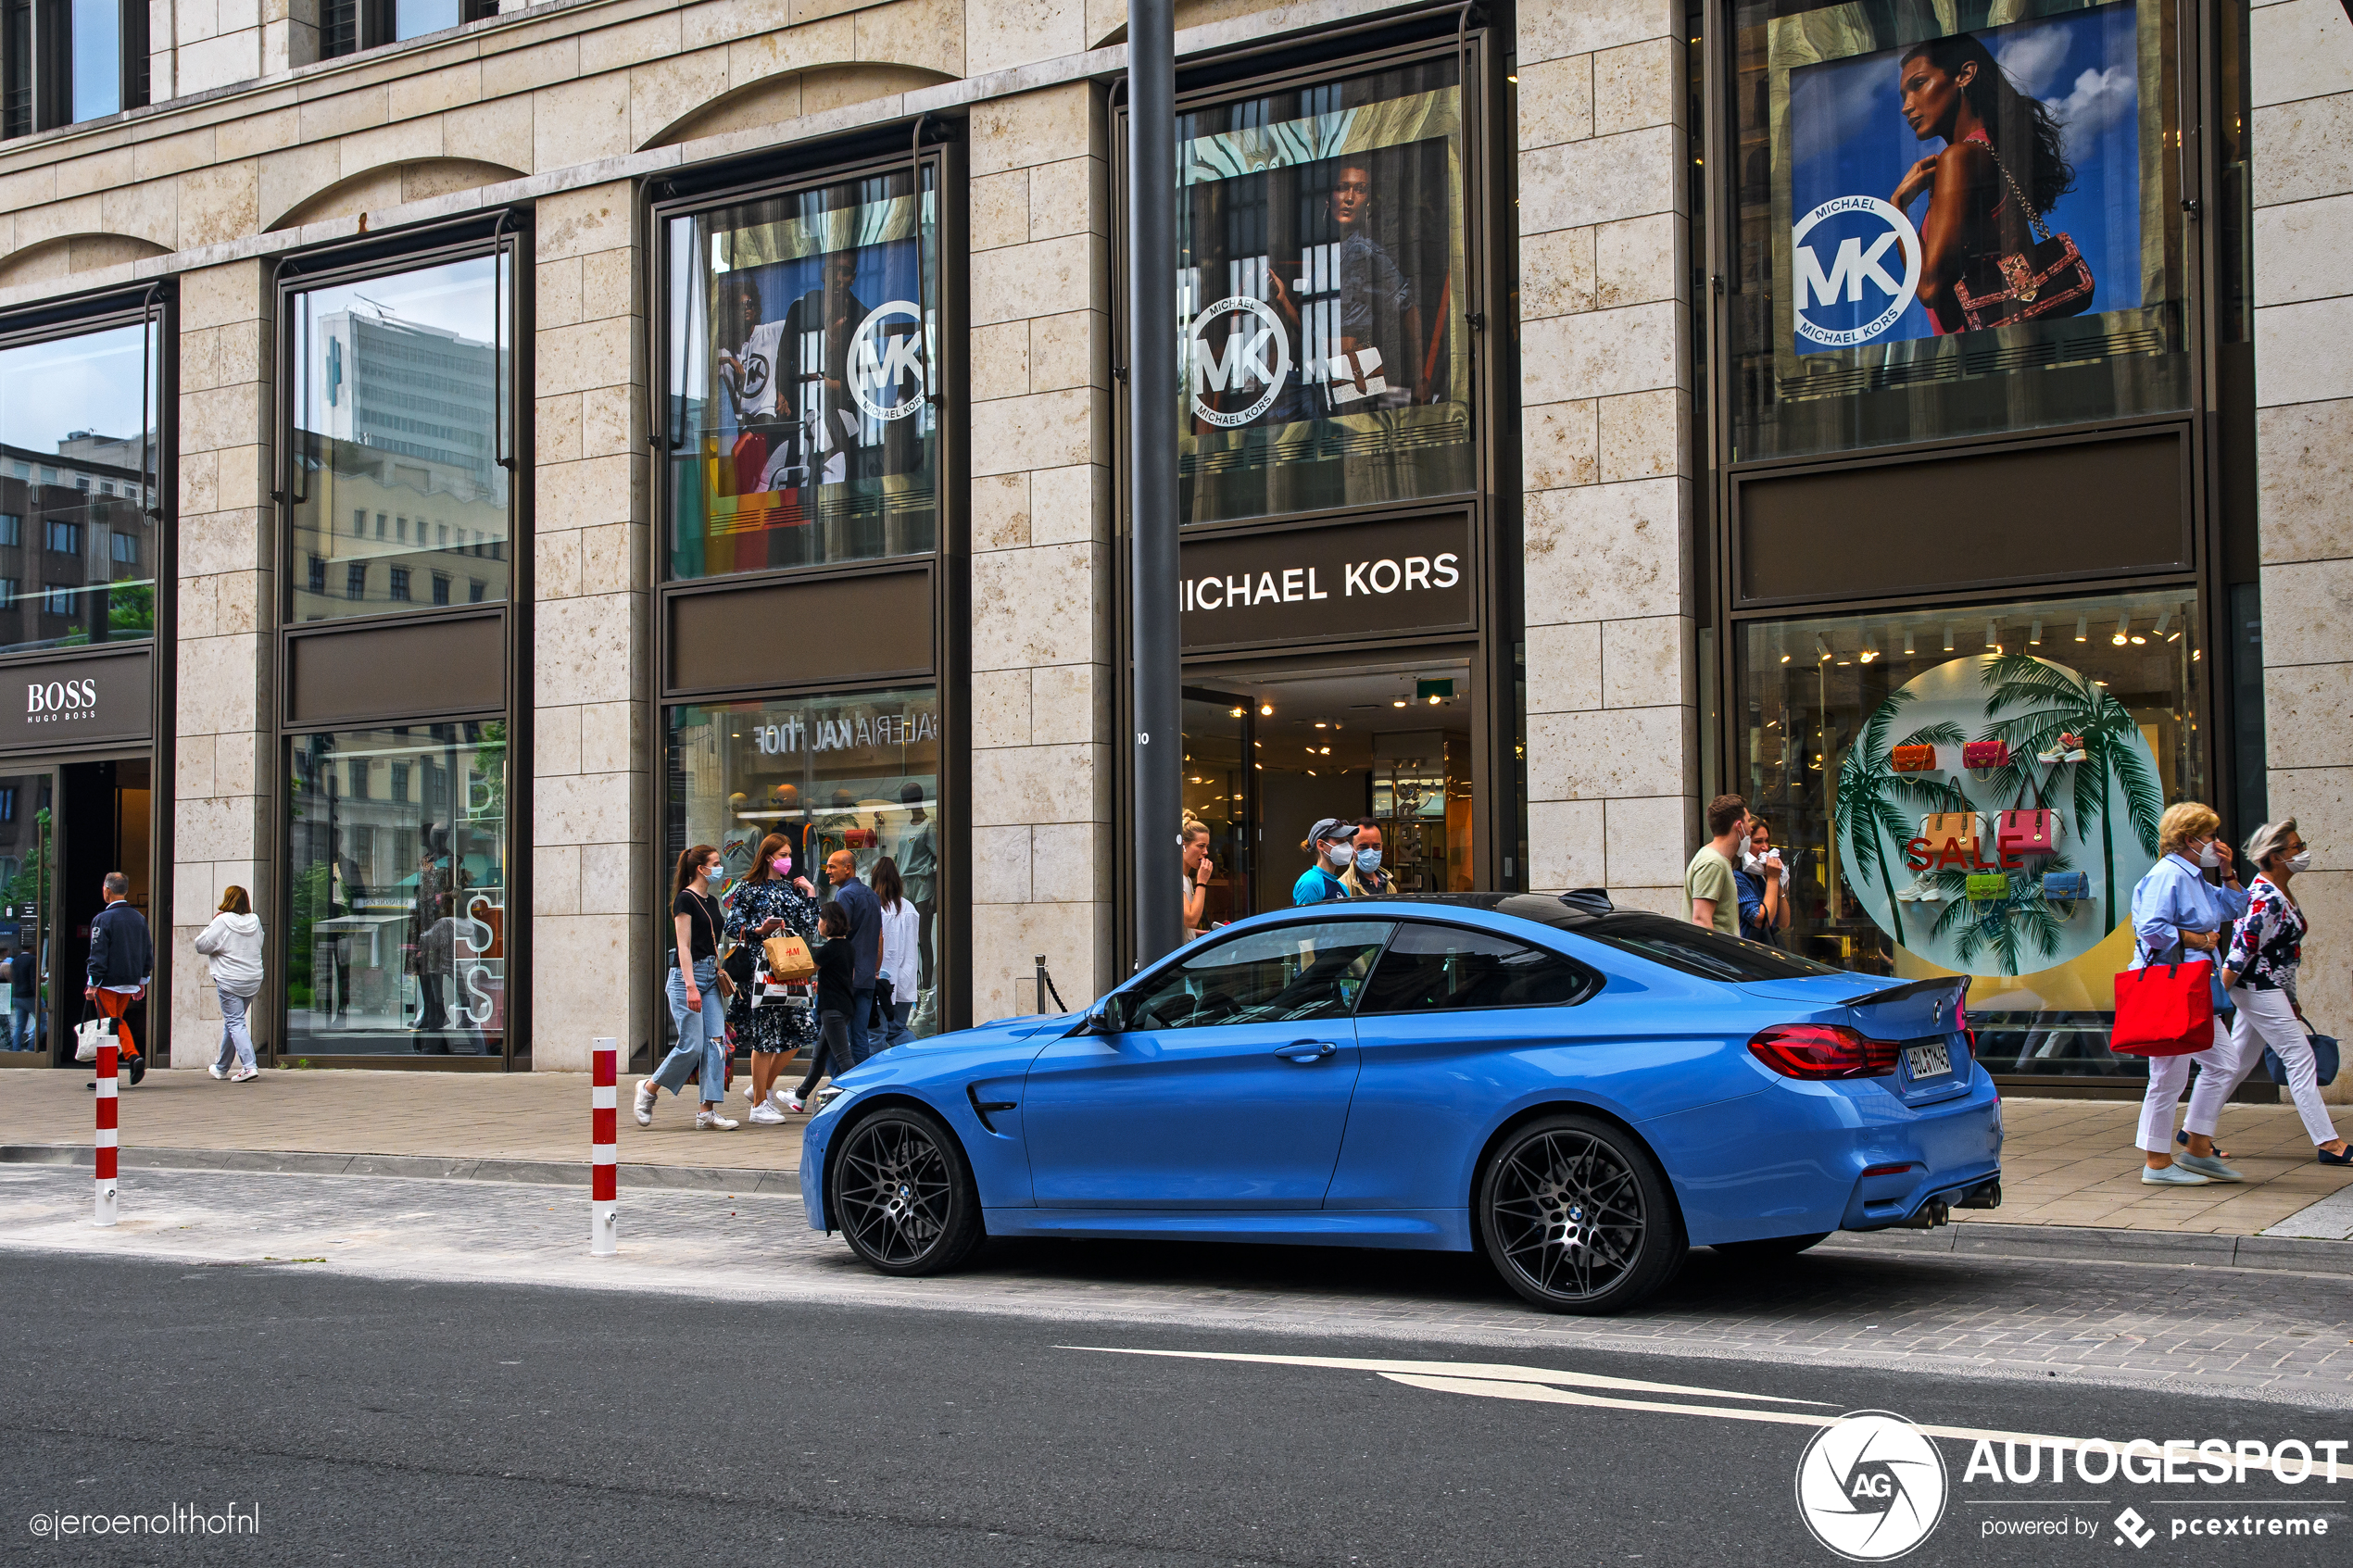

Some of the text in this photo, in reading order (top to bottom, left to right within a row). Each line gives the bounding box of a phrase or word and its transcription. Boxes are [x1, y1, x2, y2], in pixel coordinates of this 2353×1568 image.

[1815, 198, 1875, 220] MICHAEL
[1793, 231, 1902, 307] MK
[1210, 298, 1255, 316] MICHAEL
[1799, 308, 1899, 344] MICHAEL KORS
[1194, 328, 1275, 395] MK
[862, 400, 902, 420] MICHAEL
[1197, 395, 1272, 425] MICHAEL KORS
[1179, 552, 1460, 612] ICHAEL KORS
[27, 678, 97, 713] BOSS
[27, 709, 95, 723] HUGO BOSS
[1137, 732, 1150, 745] 10
[1397, 783, 1423, 862] KORS
[1906, 834, 2024, 872] SALE
